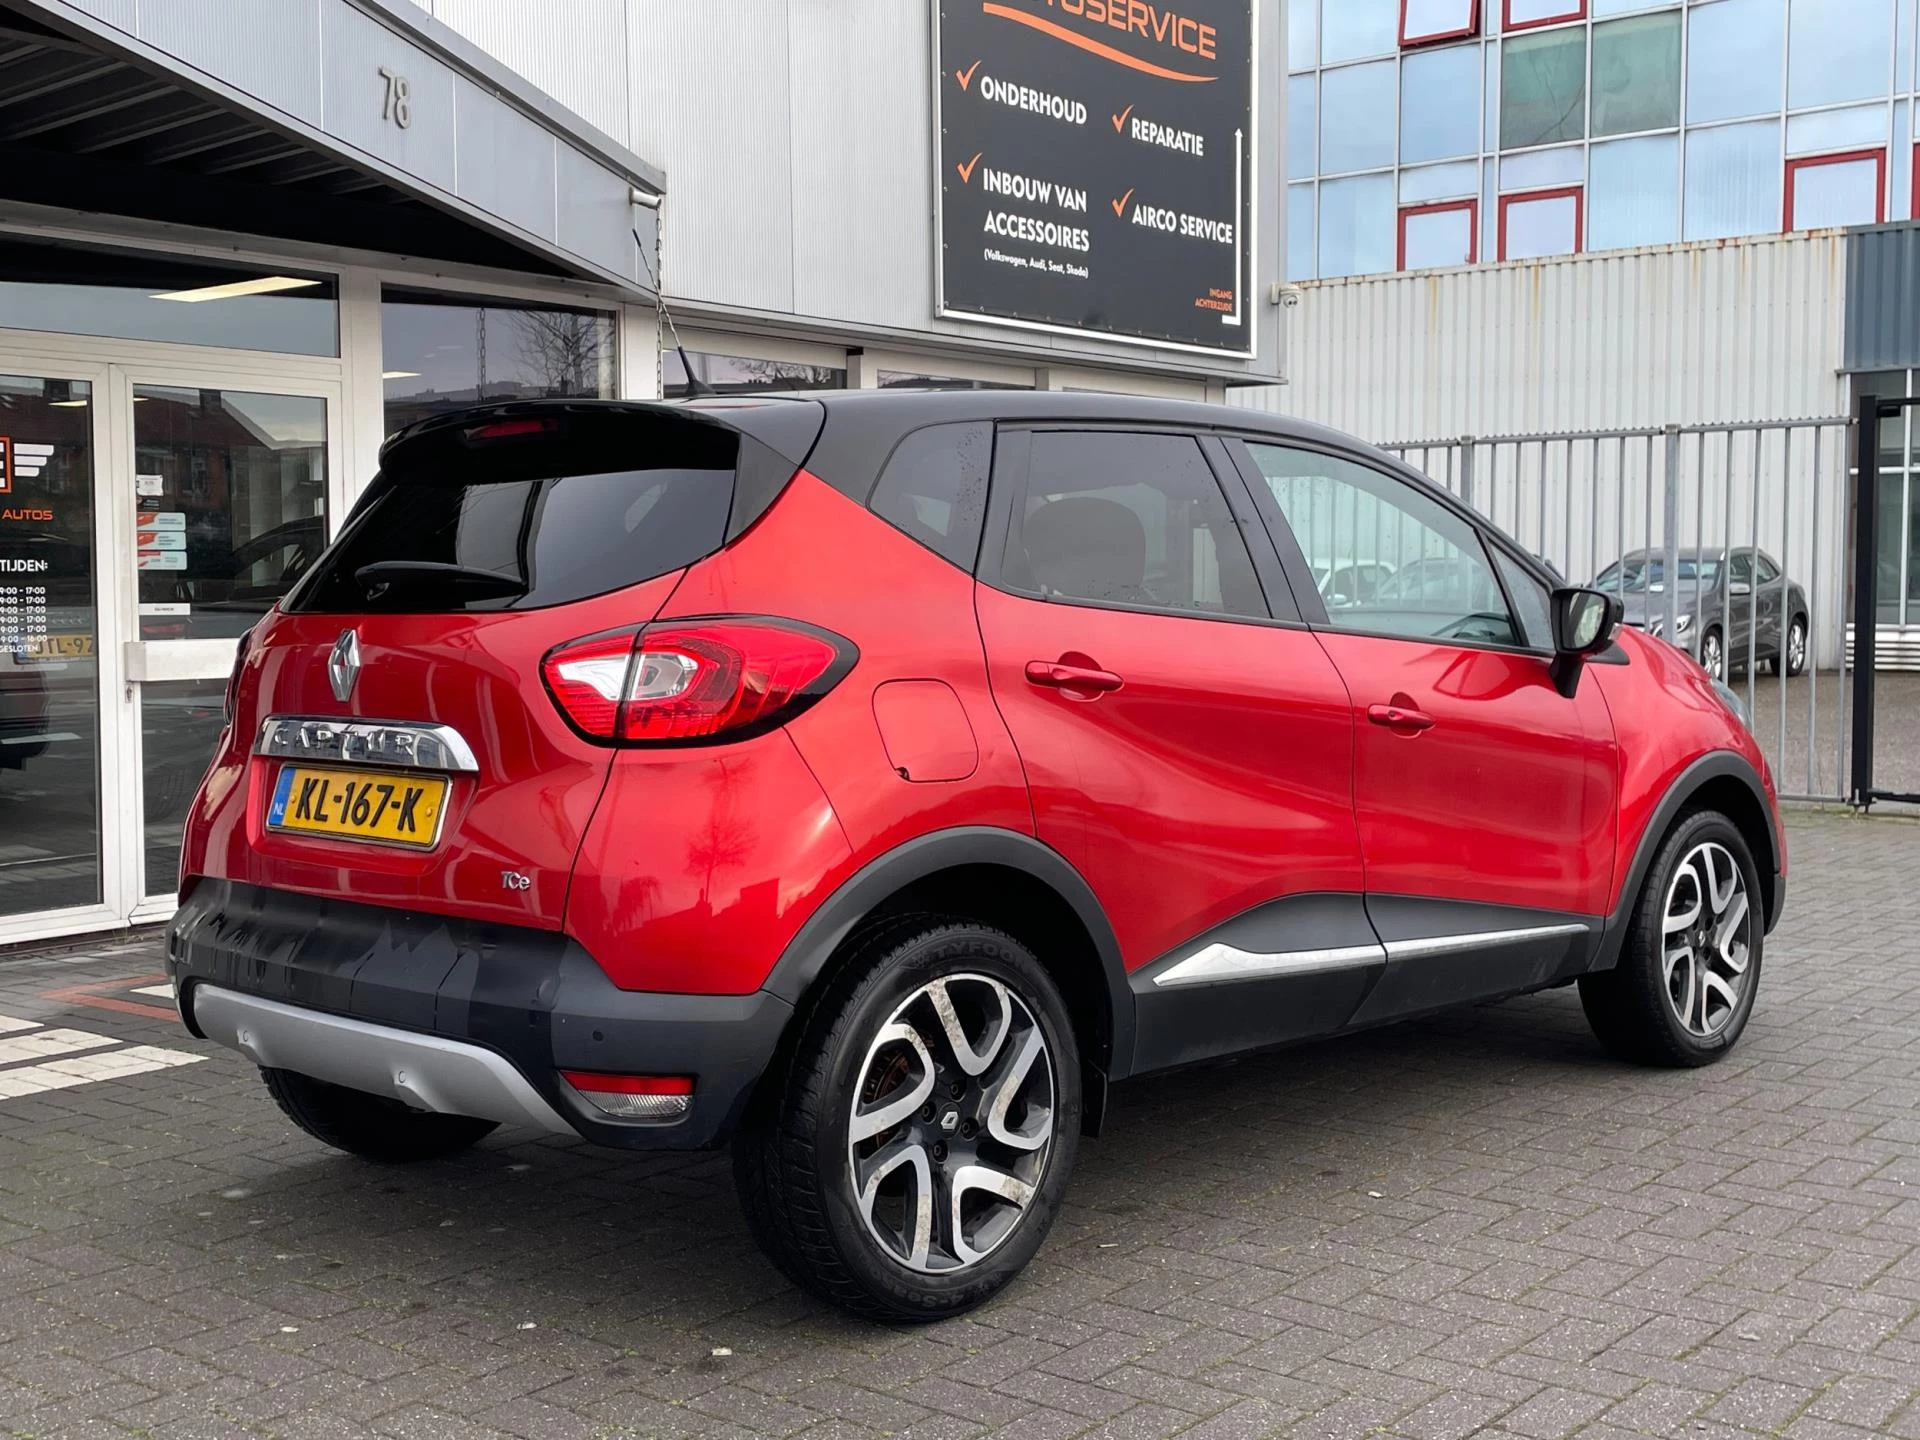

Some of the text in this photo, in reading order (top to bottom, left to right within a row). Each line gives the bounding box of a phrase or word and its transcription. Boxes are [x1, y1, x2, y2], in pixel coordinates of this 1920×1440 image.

[378, 65, 412, 130] 78
[980, 75, 1088, 125] ONDERHOUD
[1131, 117, 1204, 157] REPARATIE
[983, 167, 1087, 213] INBOUW VAN
[983, 210, 1090, 252] ACCESSOIRES
[1131, 203, 1233, 244] AIRCO SERVICE
[2, 509, 54, 520] AUTOS
[273, 802, 284, 816] NL
[294, 777, 425, 834] KL-167-K
[501, 871, 531, 891] TCe
